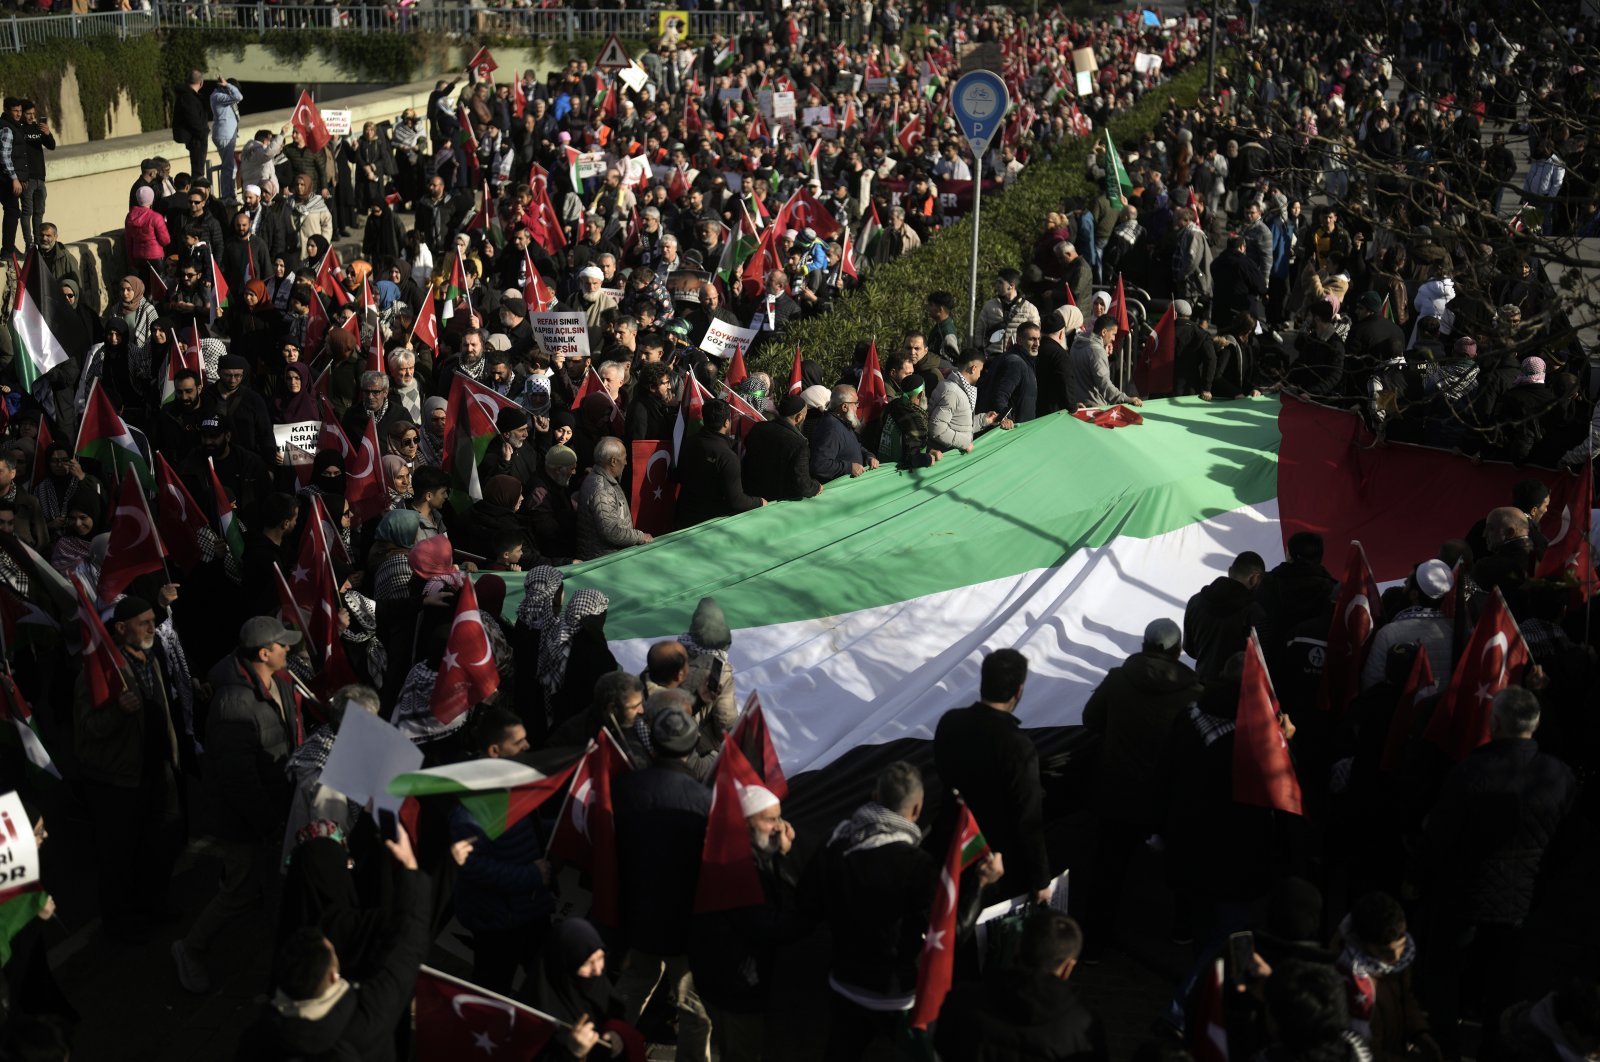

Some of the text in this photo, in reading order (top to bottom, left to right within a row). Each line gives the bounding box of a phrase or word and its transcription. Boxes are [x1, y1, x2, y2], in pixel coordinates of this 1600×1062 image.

[974, 123, 983, 136] P
[555, 327, 585, 335] AÇILSIN
[707, 335, 723, 346] GÖZ
[292, 424, 319, 432] KATİL
